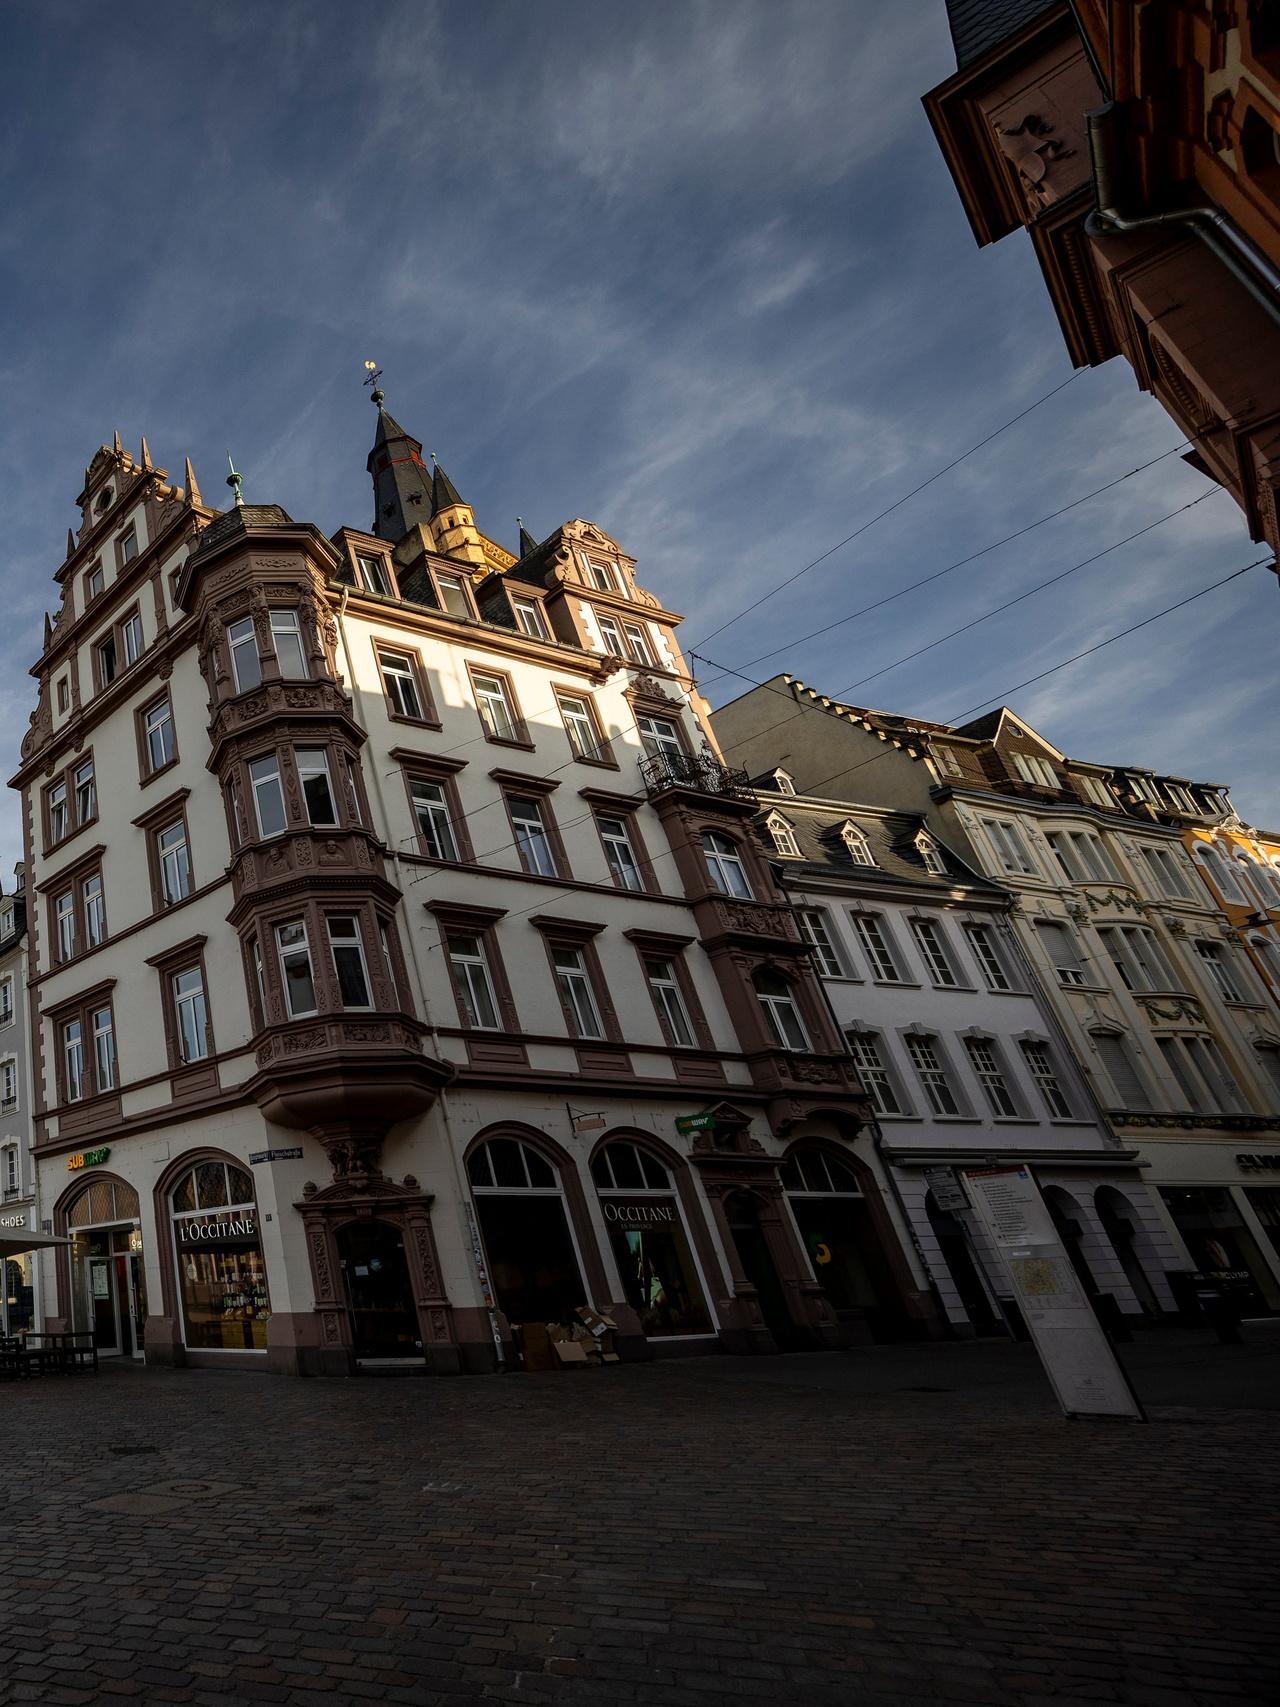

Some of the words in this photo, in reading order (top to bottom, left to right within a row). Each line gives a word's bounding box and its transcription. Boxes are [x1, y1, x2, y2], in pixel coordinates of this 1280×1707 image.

[680, 1117, 709, 1129] SUBWAY
[67, 1147, 111, 1171] SUBWAY
[0, 1214, 25, 1228] SHOES
[180, 1219, 254, 1242] L'OCCITANE
[1224, 1271, 1250, 1279] OLYMP
